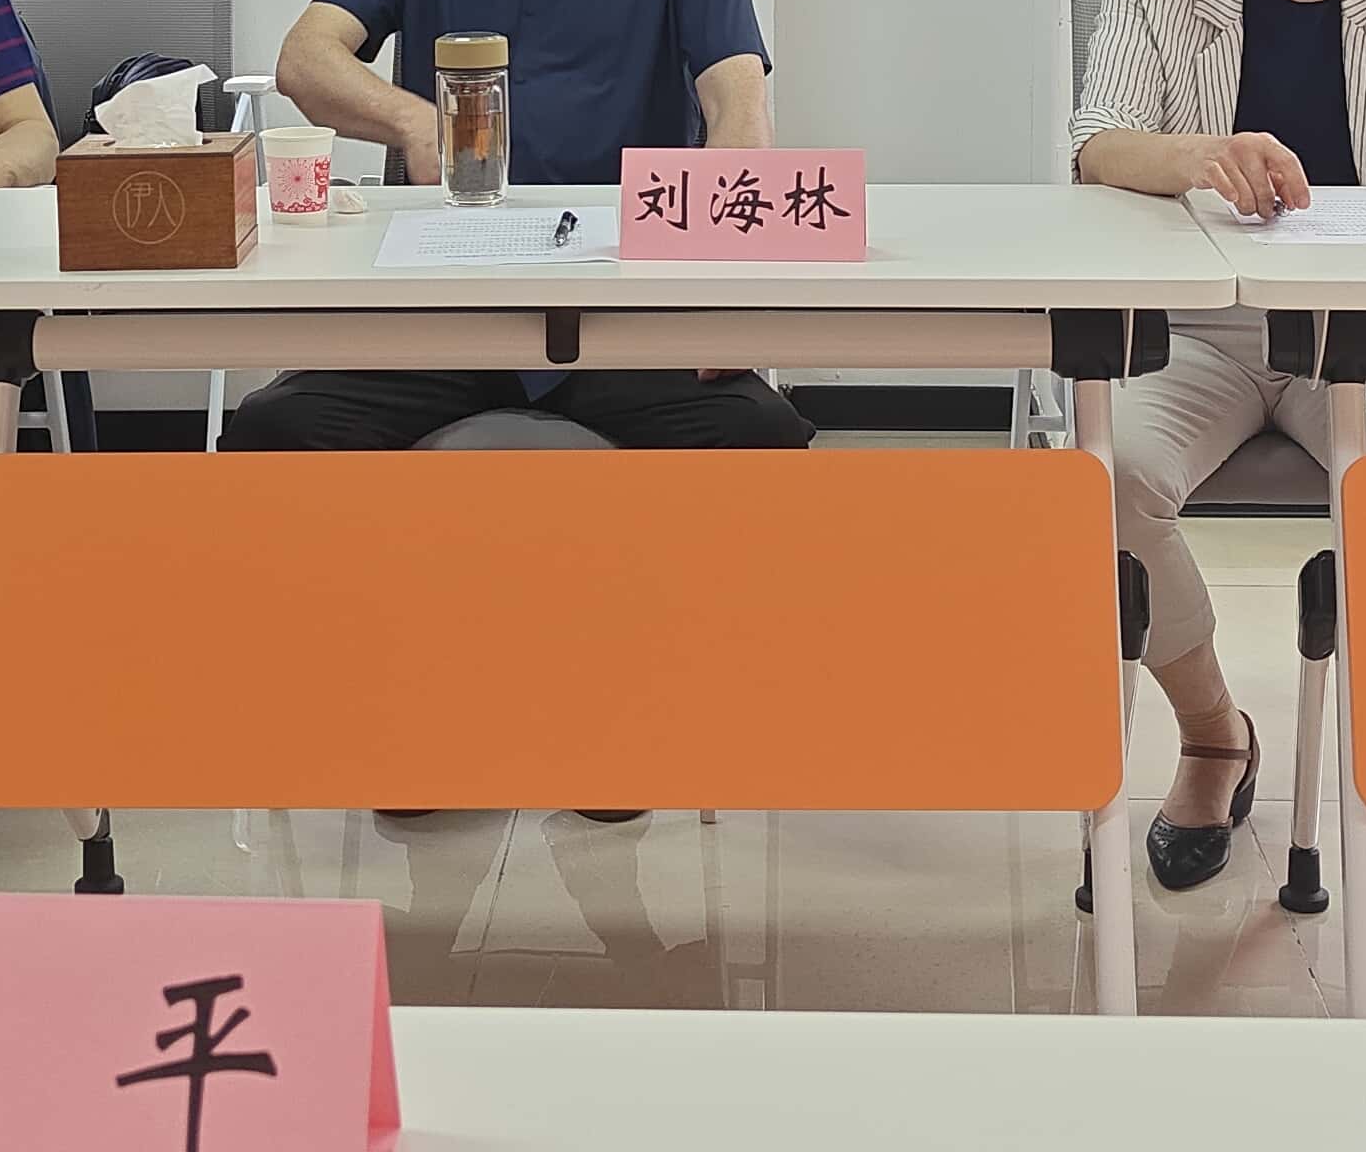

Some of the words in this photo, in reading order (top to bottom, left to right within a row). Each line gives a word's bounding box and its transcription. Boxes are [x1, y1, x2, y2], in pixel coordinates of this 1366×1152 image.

[122, 181, 177, 229] 伊人
[635, 165, 852, 234] 刘海林
